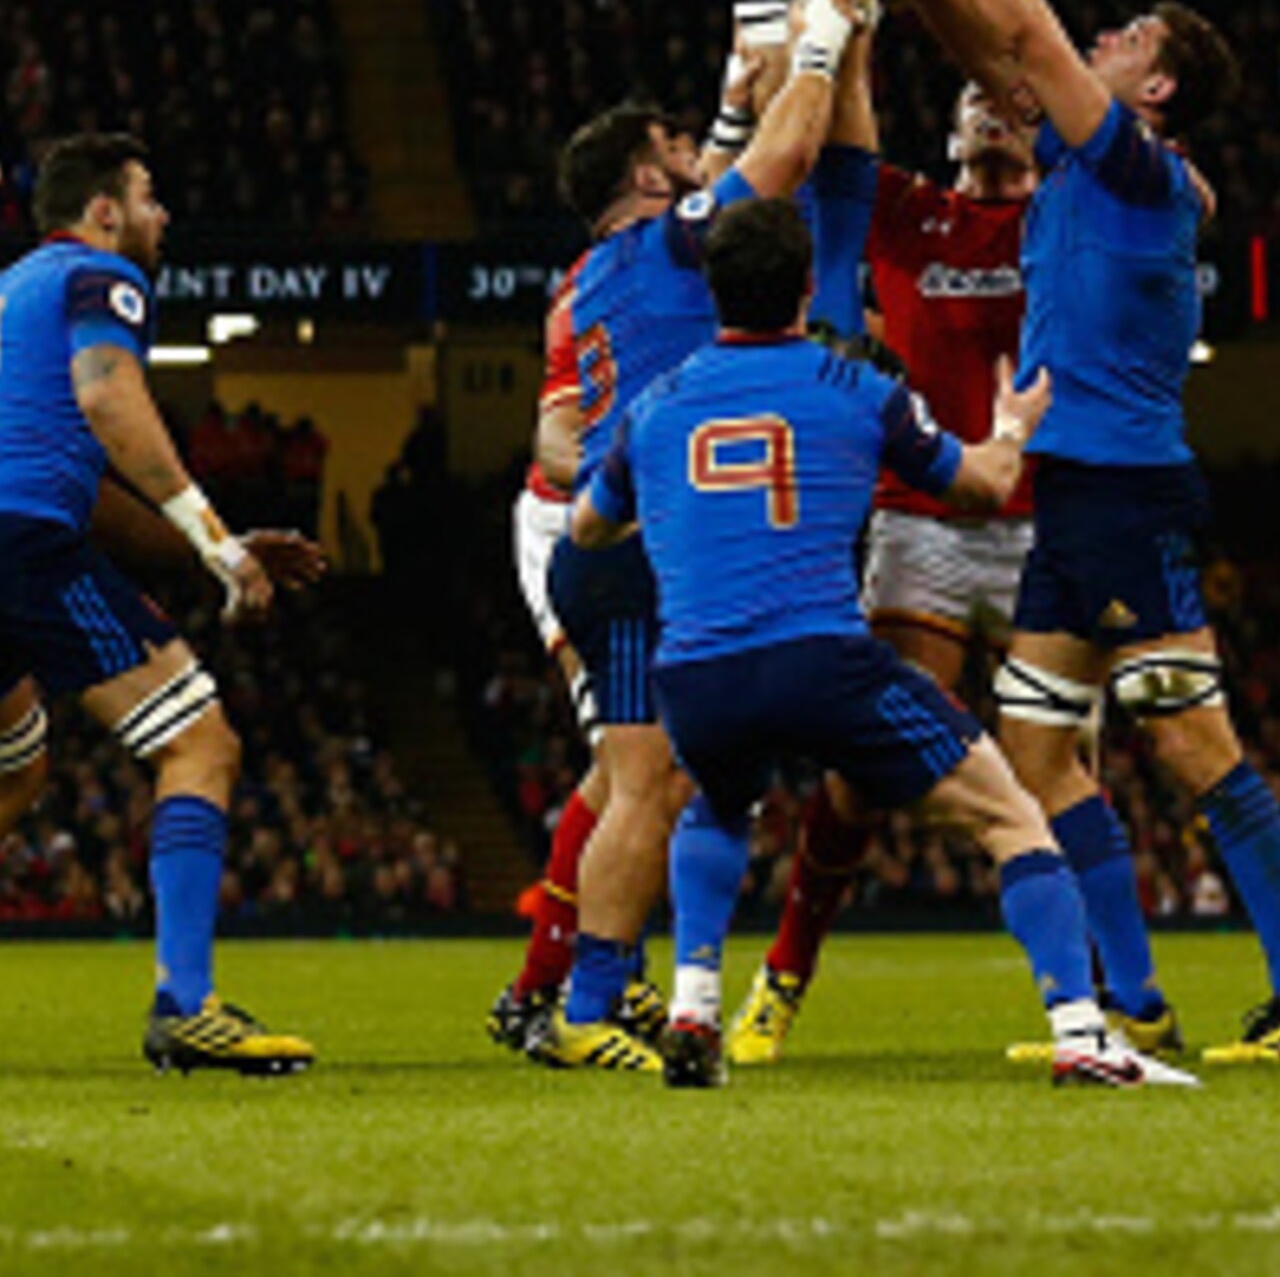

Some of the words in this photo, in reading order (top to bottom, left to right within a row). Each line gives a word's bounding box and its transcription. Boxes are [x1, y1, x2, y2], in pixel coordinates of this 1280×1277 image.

[248, 263, 327, 300] DAY
[342, 264, 389, 300] IV
[688, 411, 801, 531] 9
